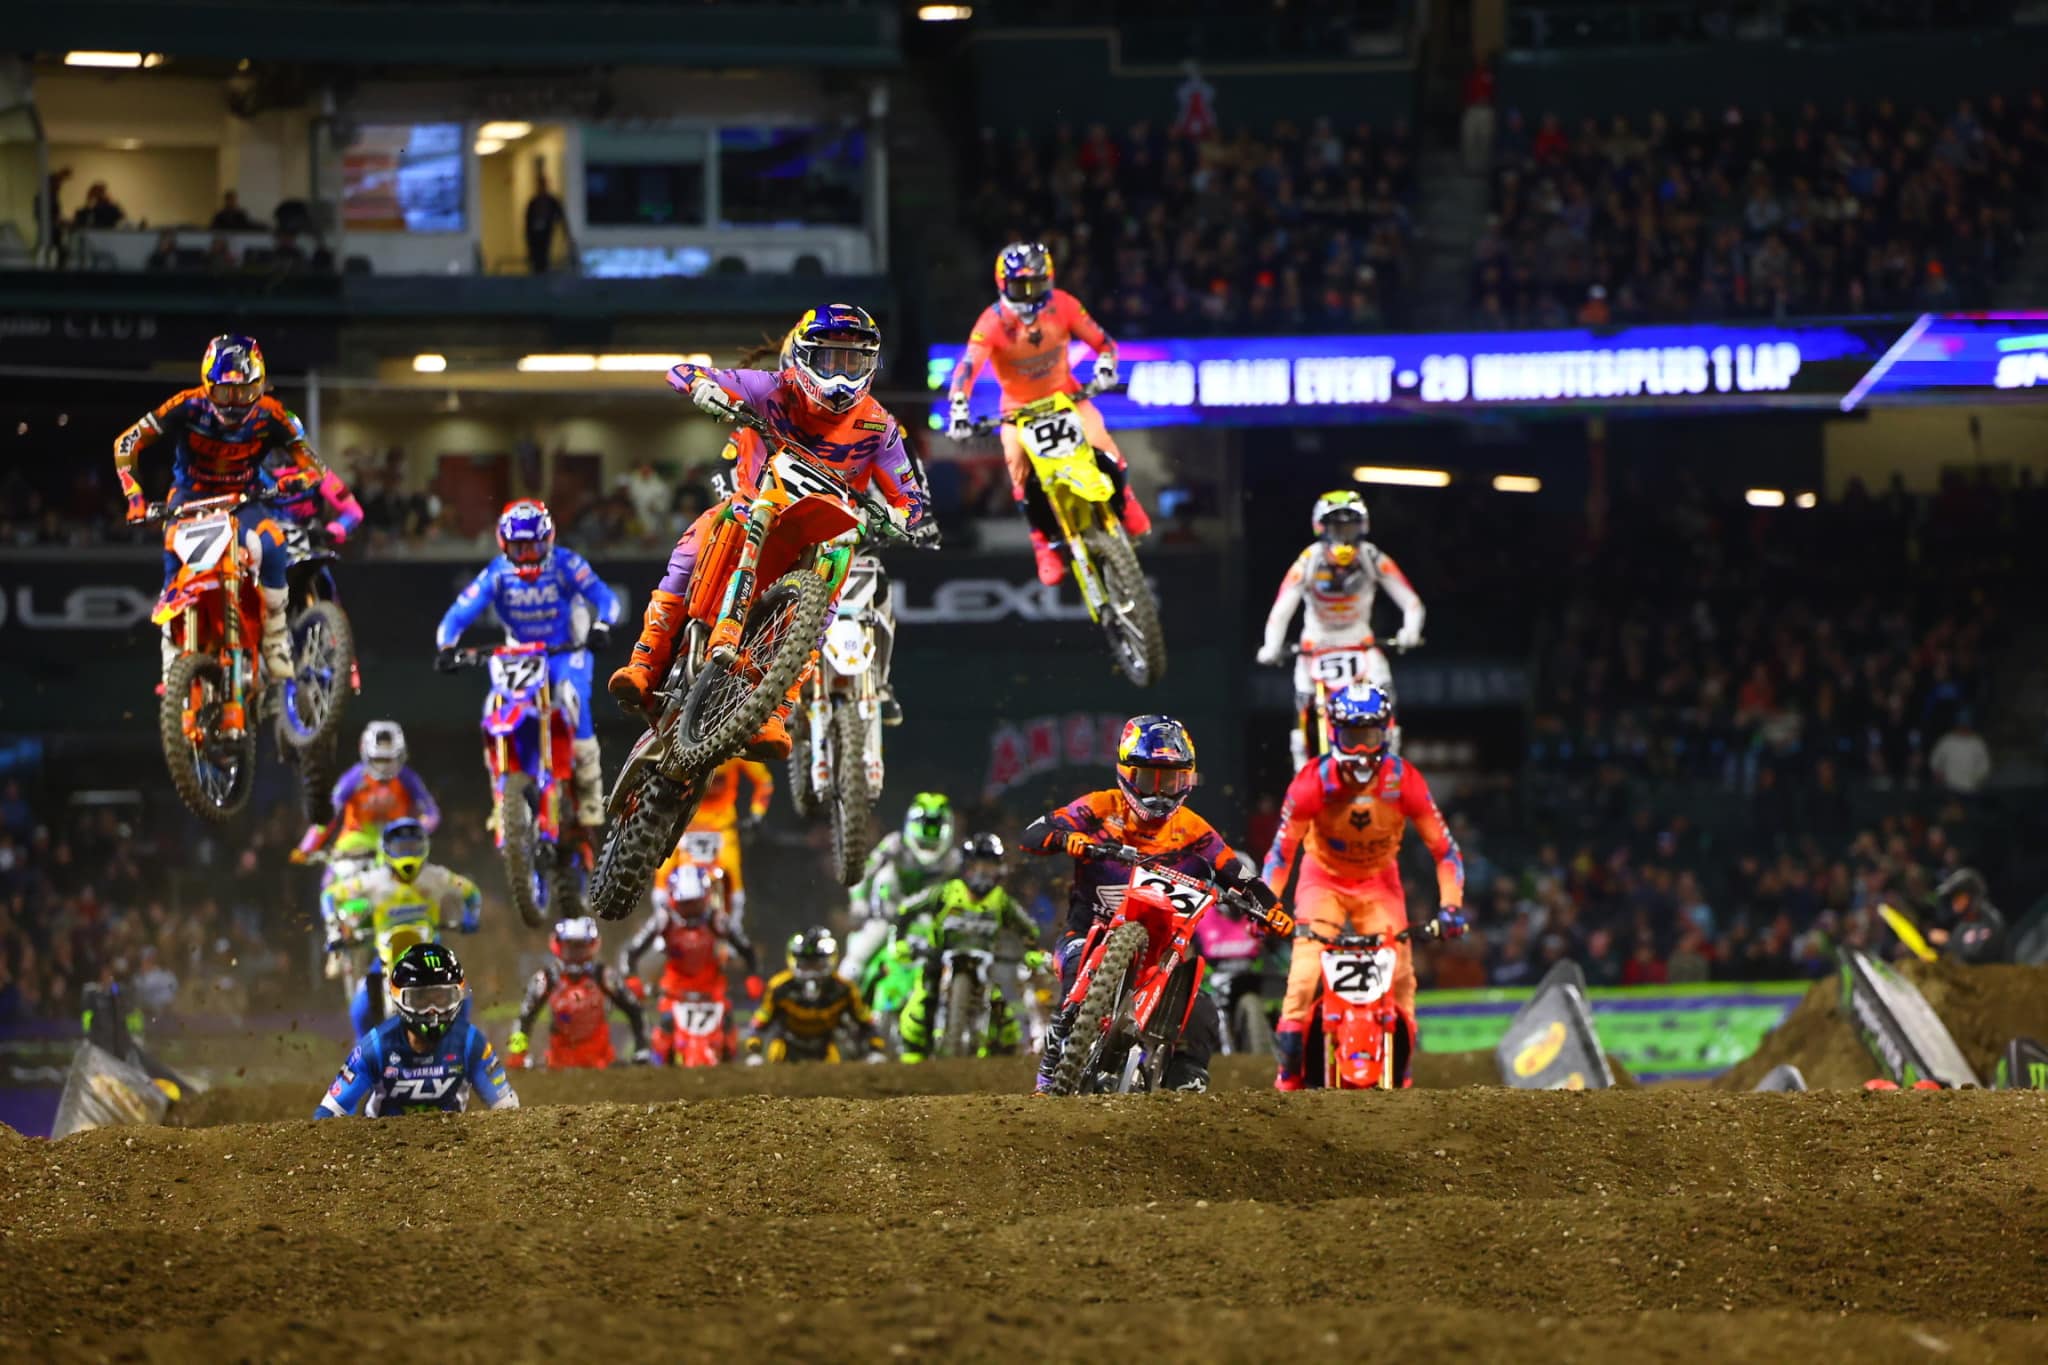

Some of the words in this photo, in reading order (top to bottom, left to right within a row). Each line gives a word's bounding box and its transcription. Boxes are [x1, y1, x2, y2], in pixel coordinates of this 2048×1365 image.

[1198, 358, 1291, 406] MAIN
[1294, 356, 1396, 404] EVENT
[1736, 341, 1801, 392] LAP
[1034, 418, 1077, 455] 94
[185, 525, 226, 564] 7
[1319, 656, 1359, 684] 51
[686, 1009, 715, 1029] 17
[412, 1065, 444, 1078] YAMAHA
[389, 1076, 457, 1100] FLY
